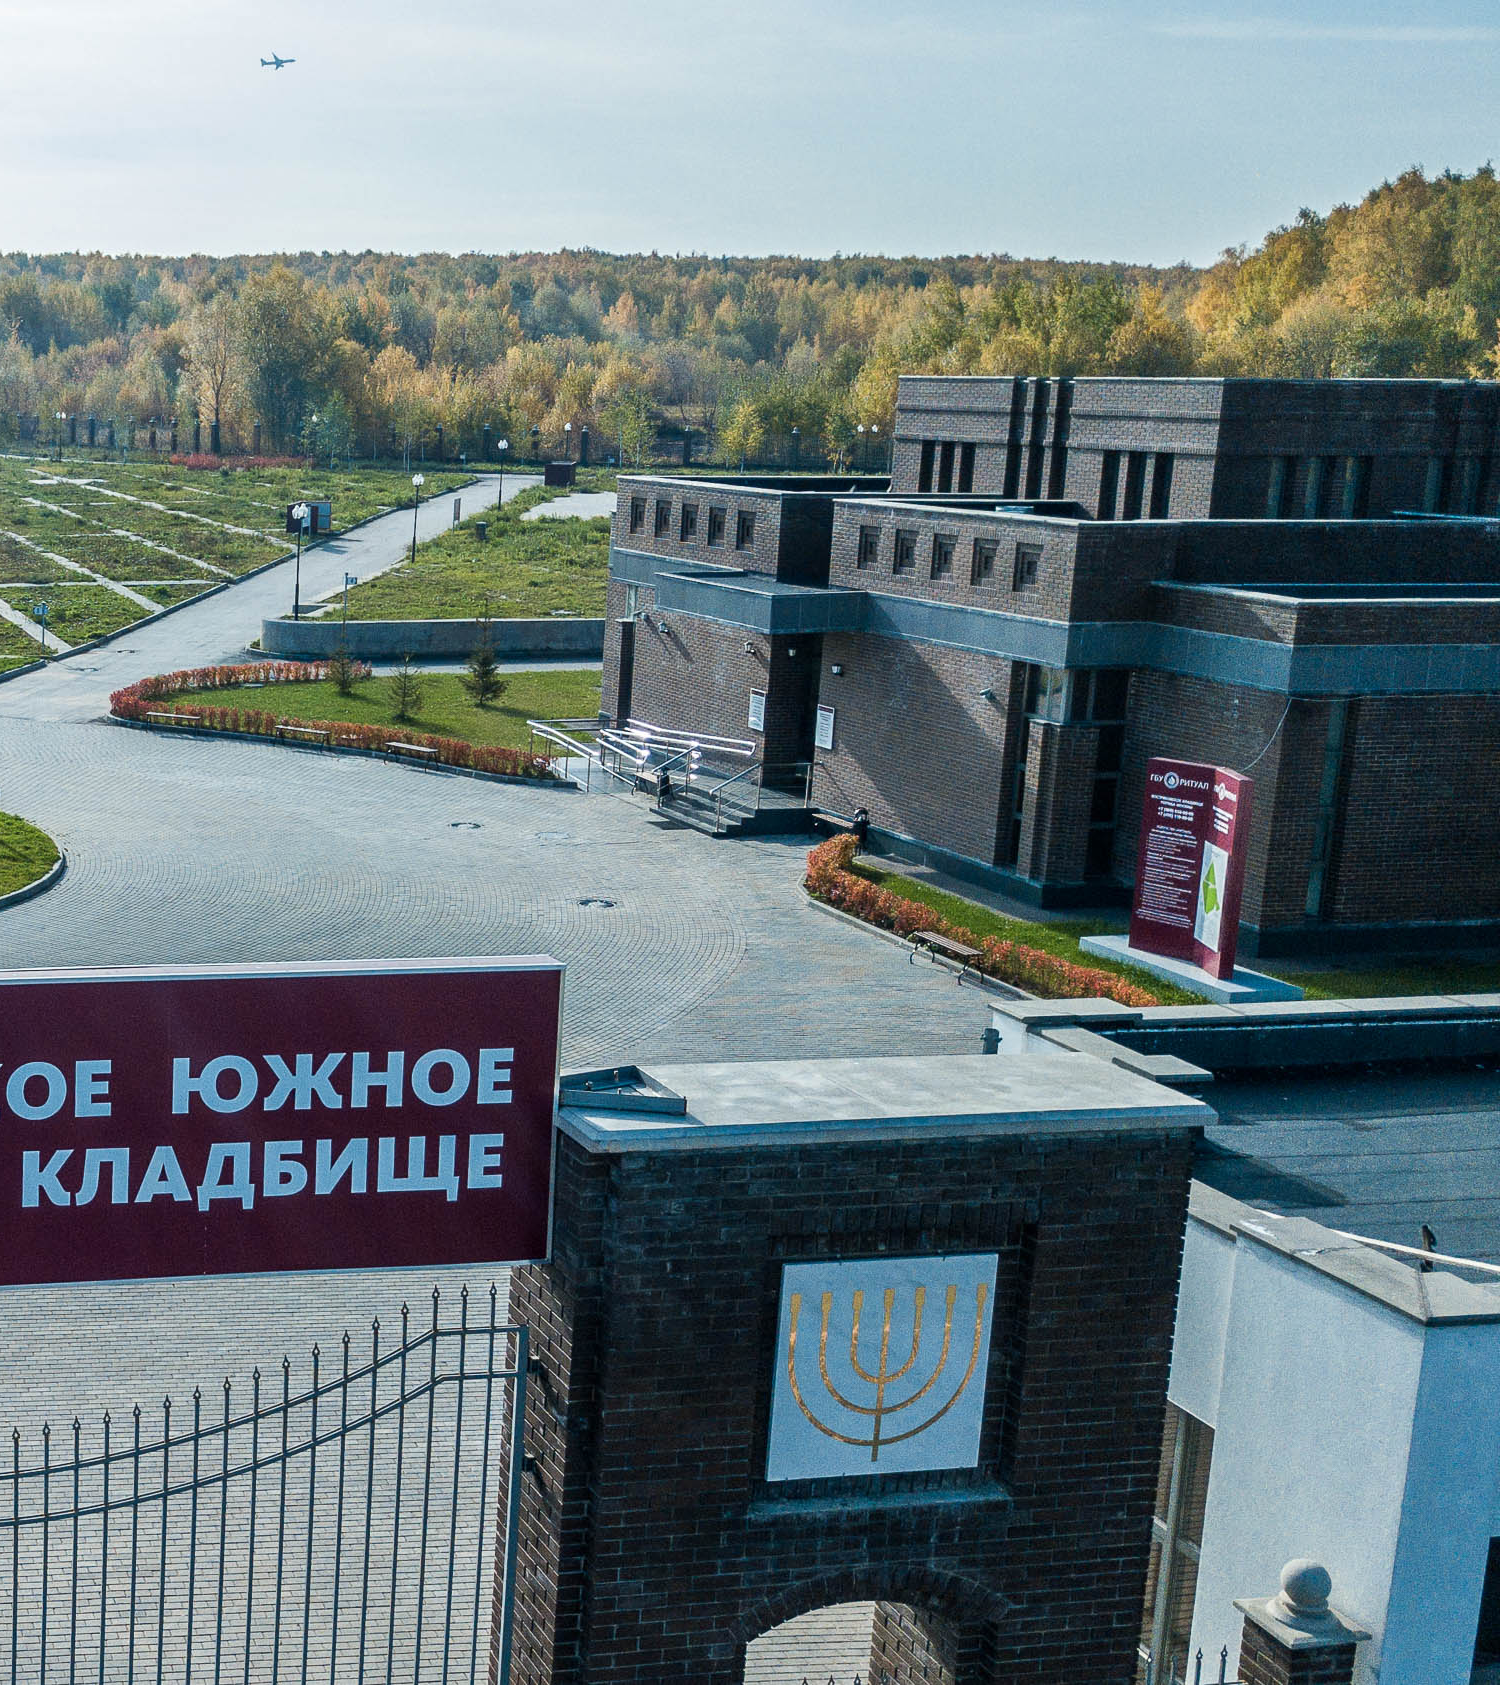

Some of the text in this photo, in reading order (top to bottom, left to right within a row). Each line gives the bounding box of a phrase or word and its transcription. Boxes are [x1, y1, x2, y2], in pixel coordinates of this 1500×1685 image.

[1150, 773, 1209, 790] ГБУ РИТУАЛ
[171, 1047, 515, 1114] ЮЖНОЕ
[21, 1133, 505, 1212] КЛАДБИЩЕ
